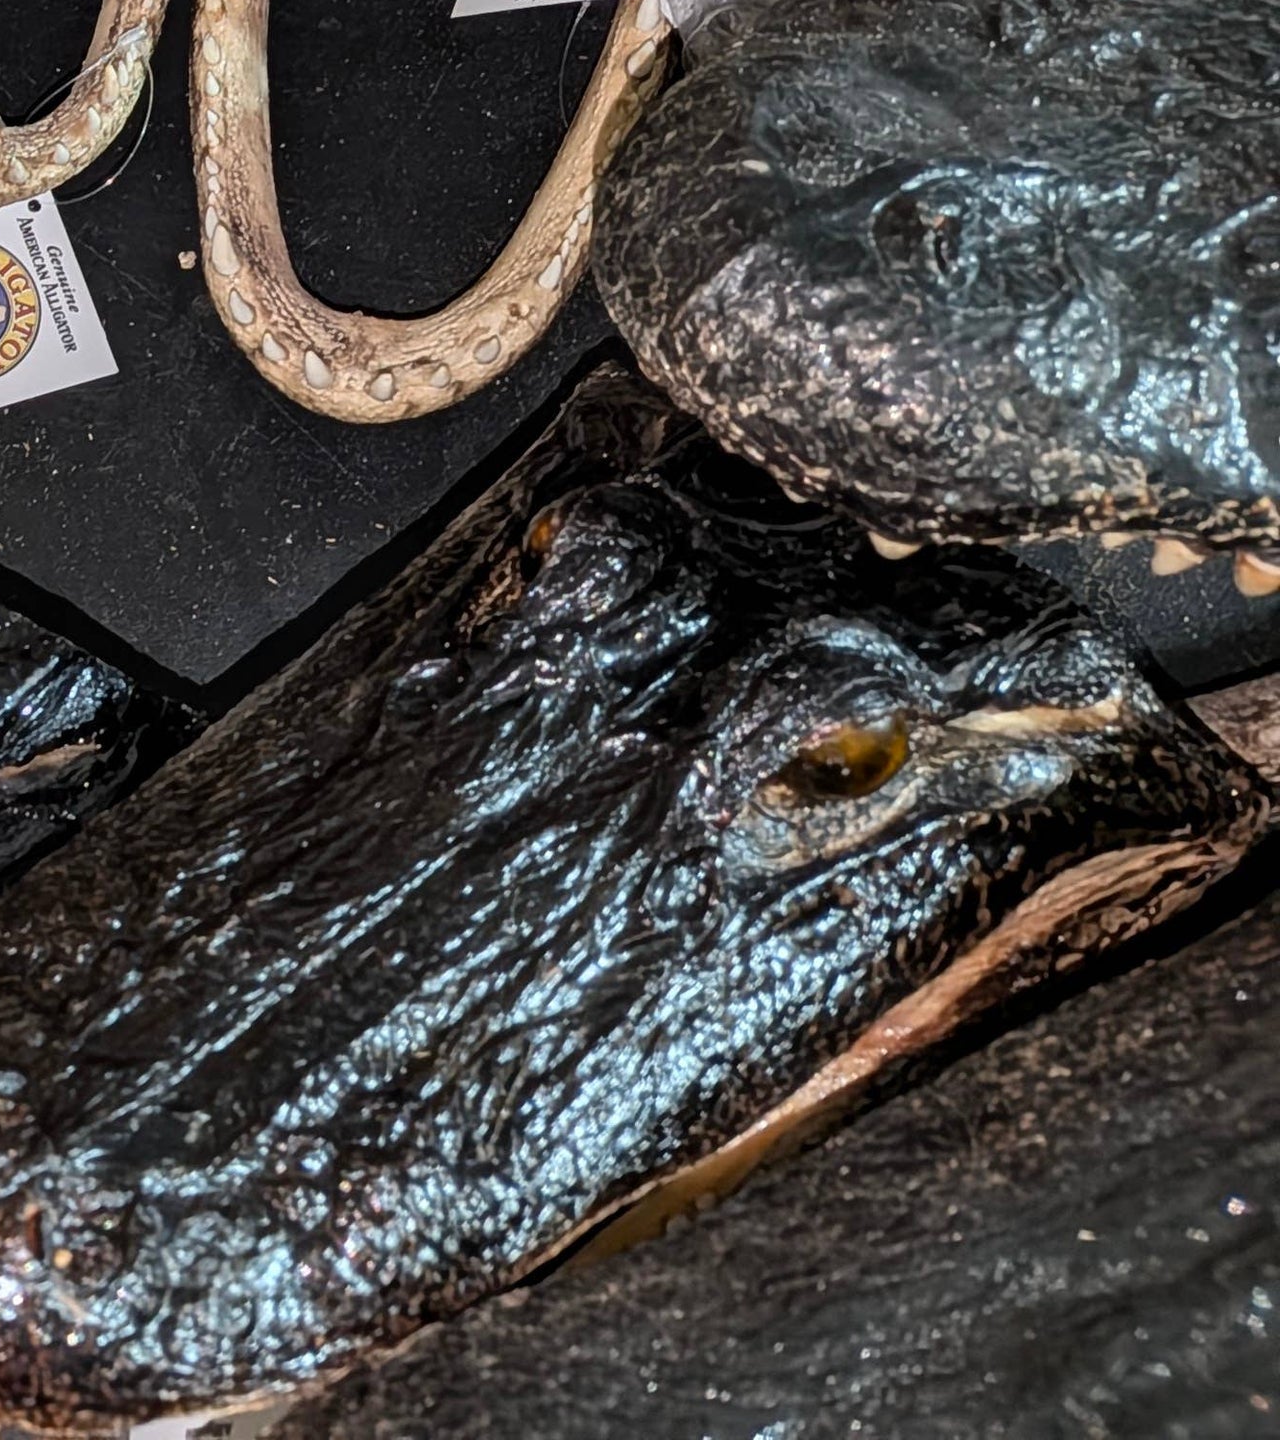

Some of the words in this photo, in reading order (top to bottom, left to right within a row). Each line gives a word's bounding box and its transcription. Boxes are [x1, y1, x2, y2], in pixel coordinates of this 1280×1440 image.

[16, 216, 50, 282] AMERICAN
[41, 279, 78, 354] ALLIGATOR
[47, 245, 80, 314] Genuine
